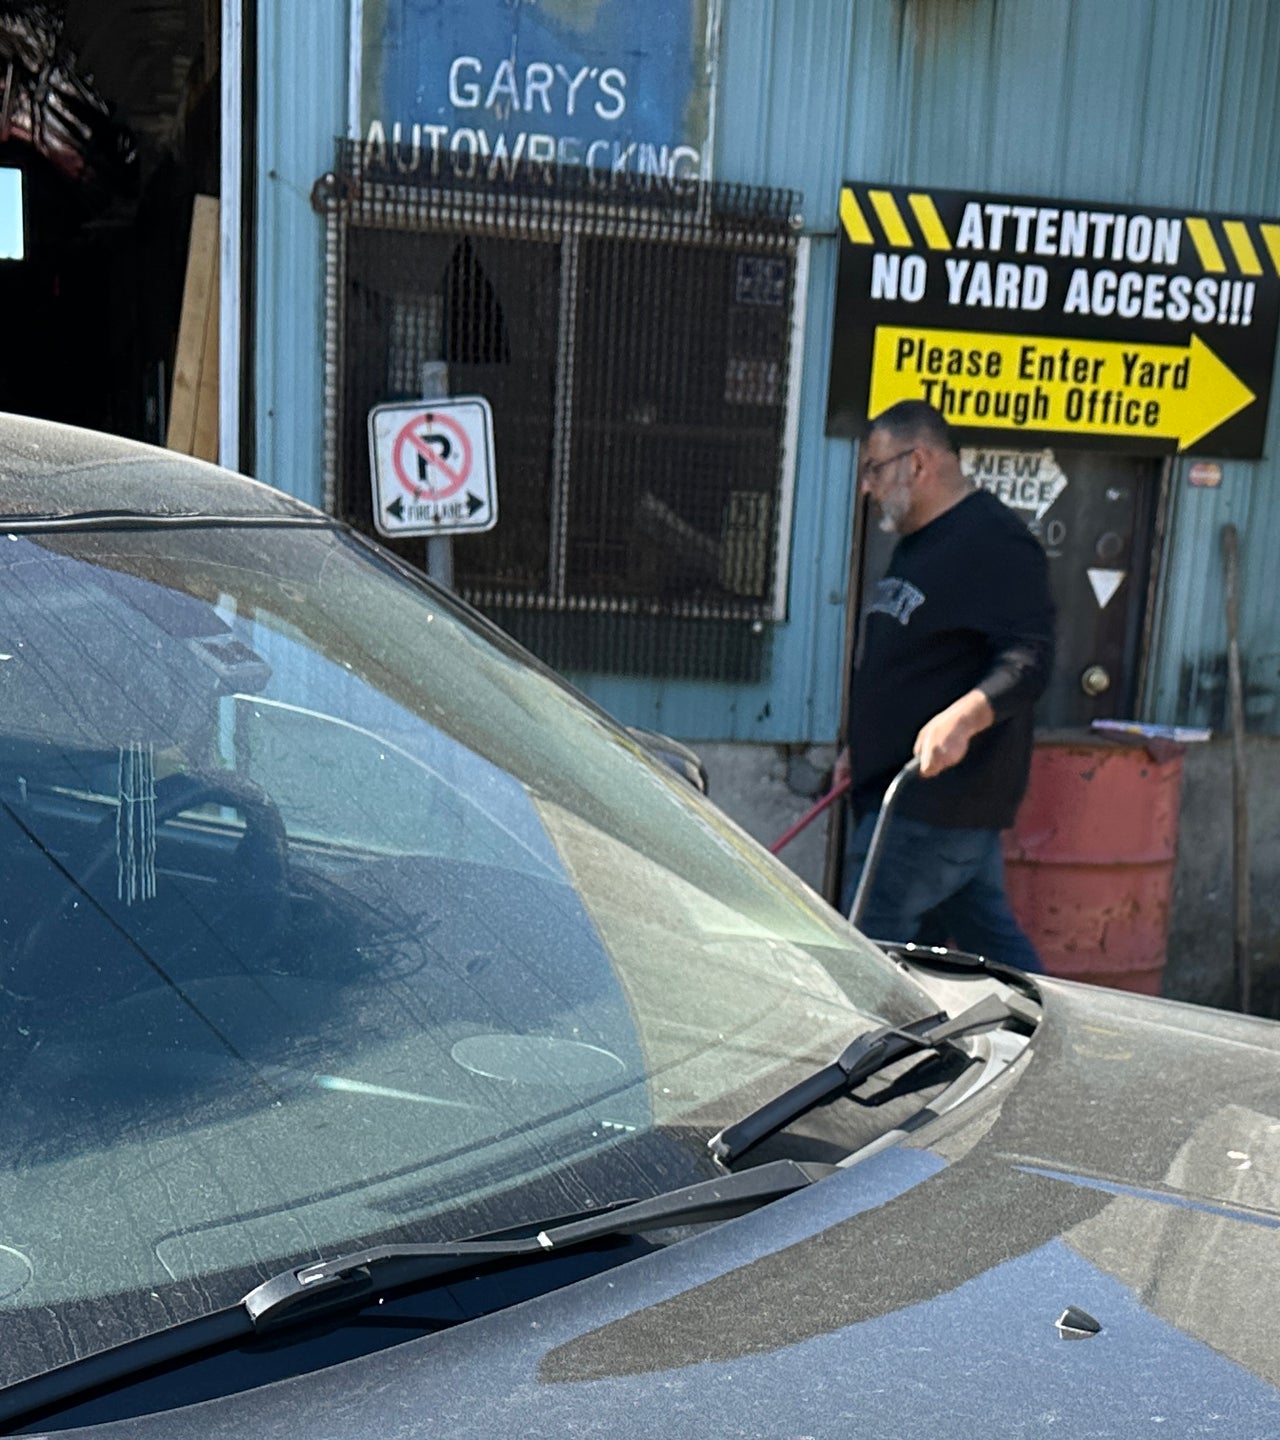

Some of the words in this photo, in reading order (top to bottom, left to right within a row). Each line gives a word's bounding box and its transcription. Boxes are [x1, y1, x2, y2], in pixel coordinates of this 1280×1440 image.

[448, 55, 628, 121] GARY'S
[956, 201, 1183, 267] ATTENTION
[870, 253, 928, 303] NO
[945, 258, 1049, 312] YARD
[1064, 267, 1256, 326] ACCESS!!!
[895, 337, 1003, 378] Please
[1018, 344, 1107, 385] Enter
[1121, 352, 1191, 391] Yard
[920, 379, 1050, 425] Through
[1066, 388, 1160, 428] Office
[975, 452, 1041, 478] NEW
